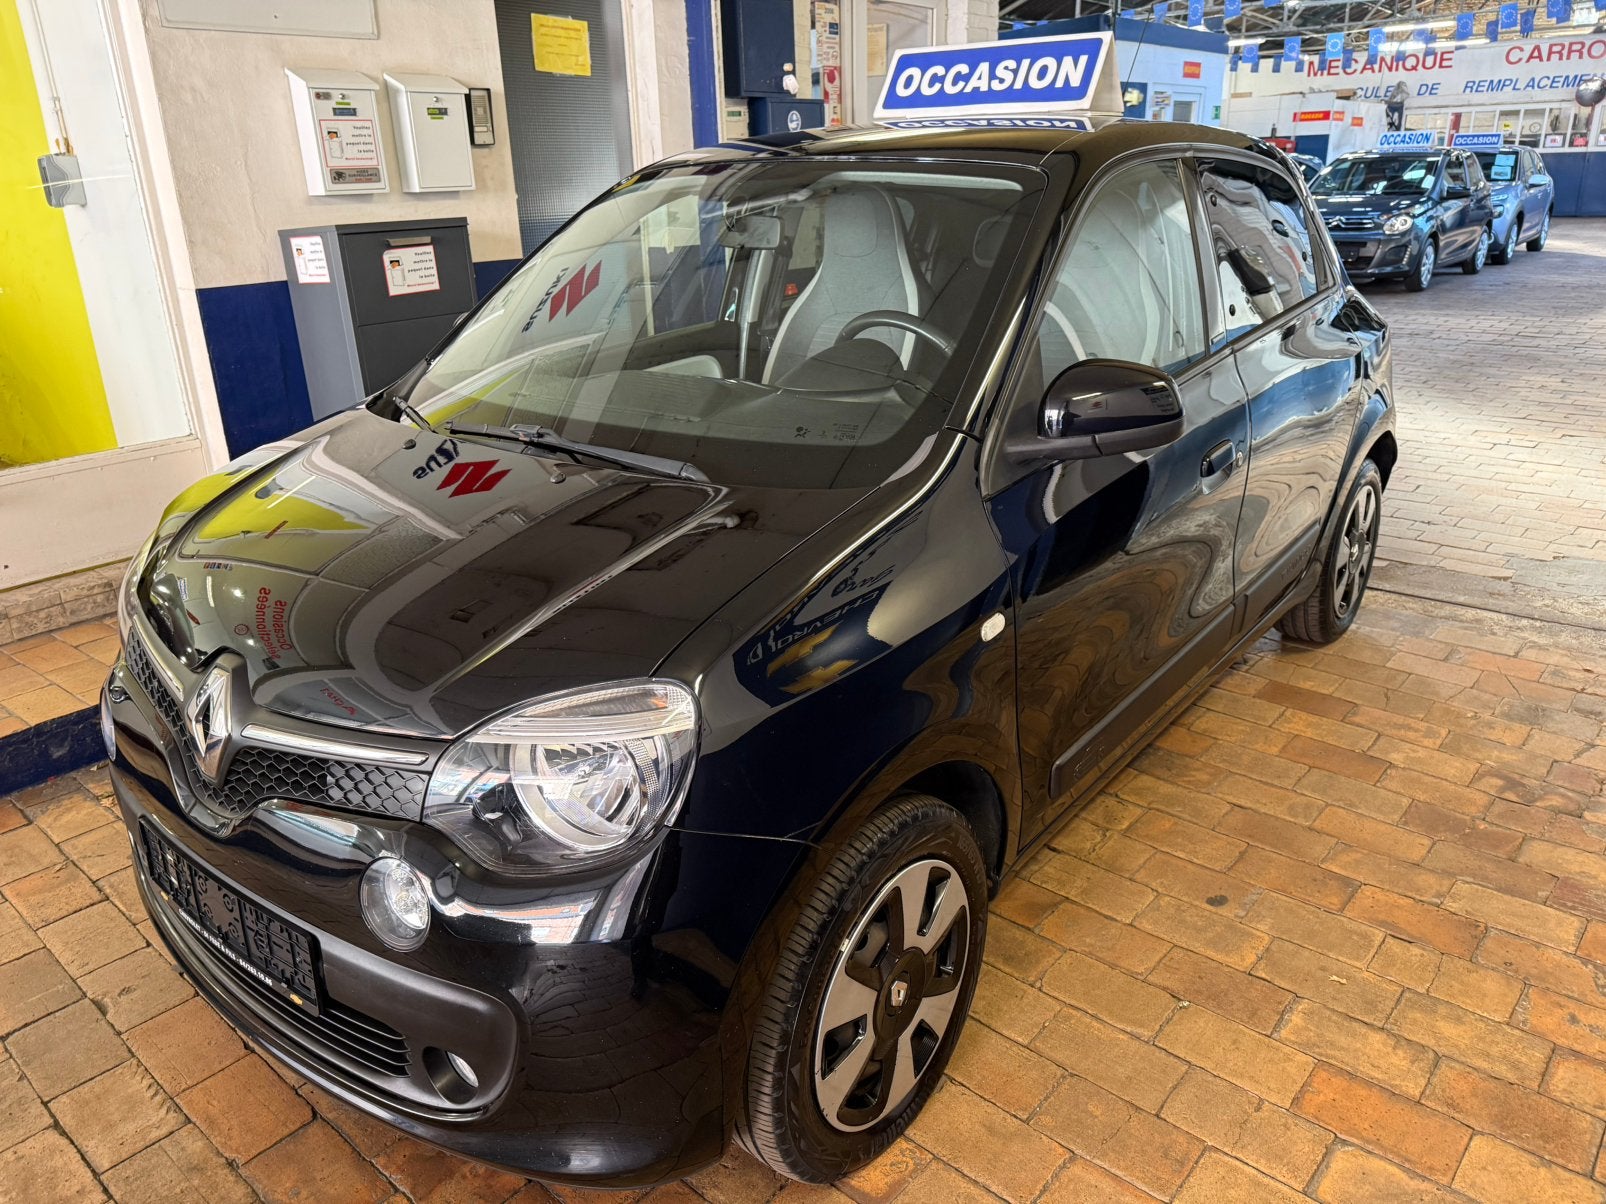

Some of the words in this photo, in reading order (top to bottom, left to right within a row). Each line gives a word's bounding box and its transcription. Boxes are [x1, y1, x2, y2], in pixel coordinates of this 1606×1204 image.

[895, 54, 1089, 98] OCCASION
[1417, 82, 1441, 96] DE
[1463, 73, 1606, 94] REMPLACEME
[1379, 132, 1433, 146] OCCASION
[1455, 136, 1499, 145] OCCASION
